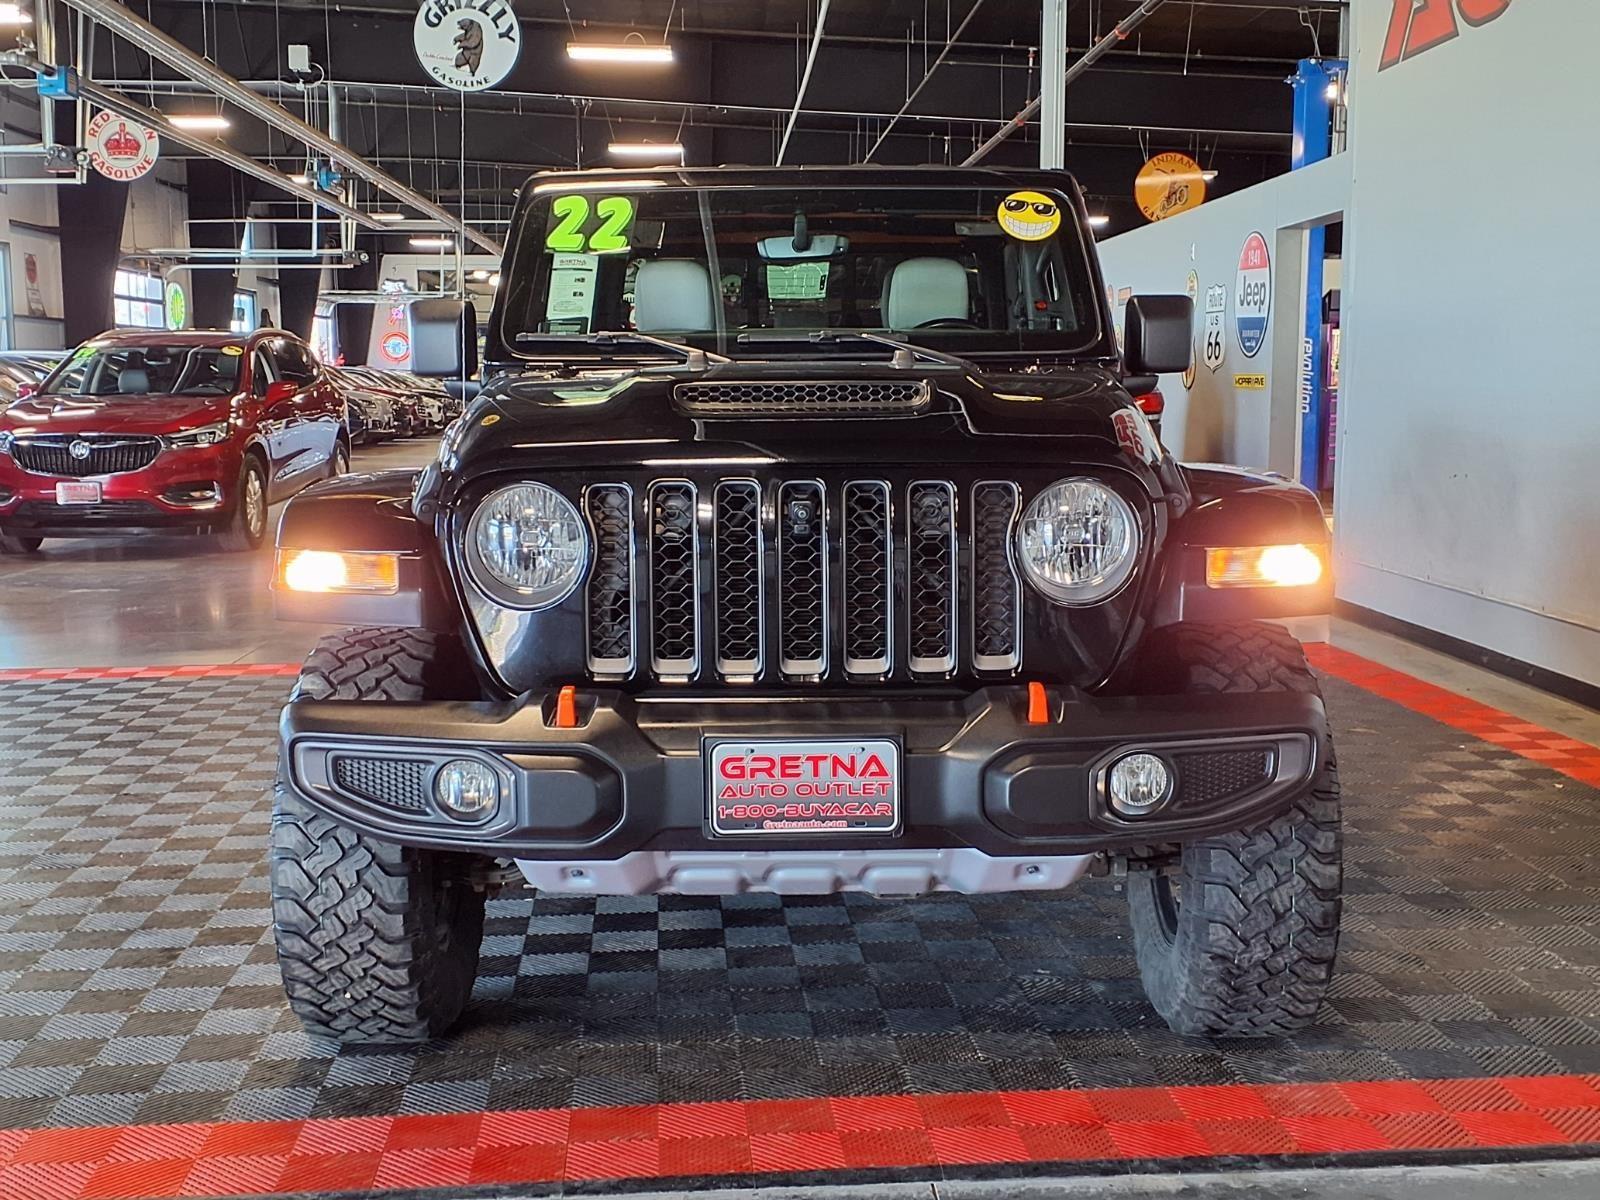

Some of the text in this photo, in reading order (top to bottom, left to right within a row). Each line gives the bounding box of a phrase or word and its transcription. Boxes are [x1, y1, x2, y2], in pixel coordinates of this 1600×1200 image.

[431, 66, 491, 88] GASOLINE
[88, 112, 110, 138] RED
[90, 151, 154, 179] GASOLINE
[1152, 154, 1194, 169] INDIAN
[1143, 206, 1167, 221] GAS
[546, 194, 633, 252] 22
[1248, 249, 1261, 266] 1941
[1208, 292, 1223, 308] ROUTE
[1239, 275, 1267, 313] Jeep
[1210, 314, 1219, 326] US
[1206, 331, 1221, 361] 66
[719, 754, 892, 781] GRETNA
[719, 781, 893, 799] AUTO OUTLET
[718, 803, 892, 819] 1-800-BUYACAR
[763, 819, 848, 830] Gretnaauto.com
